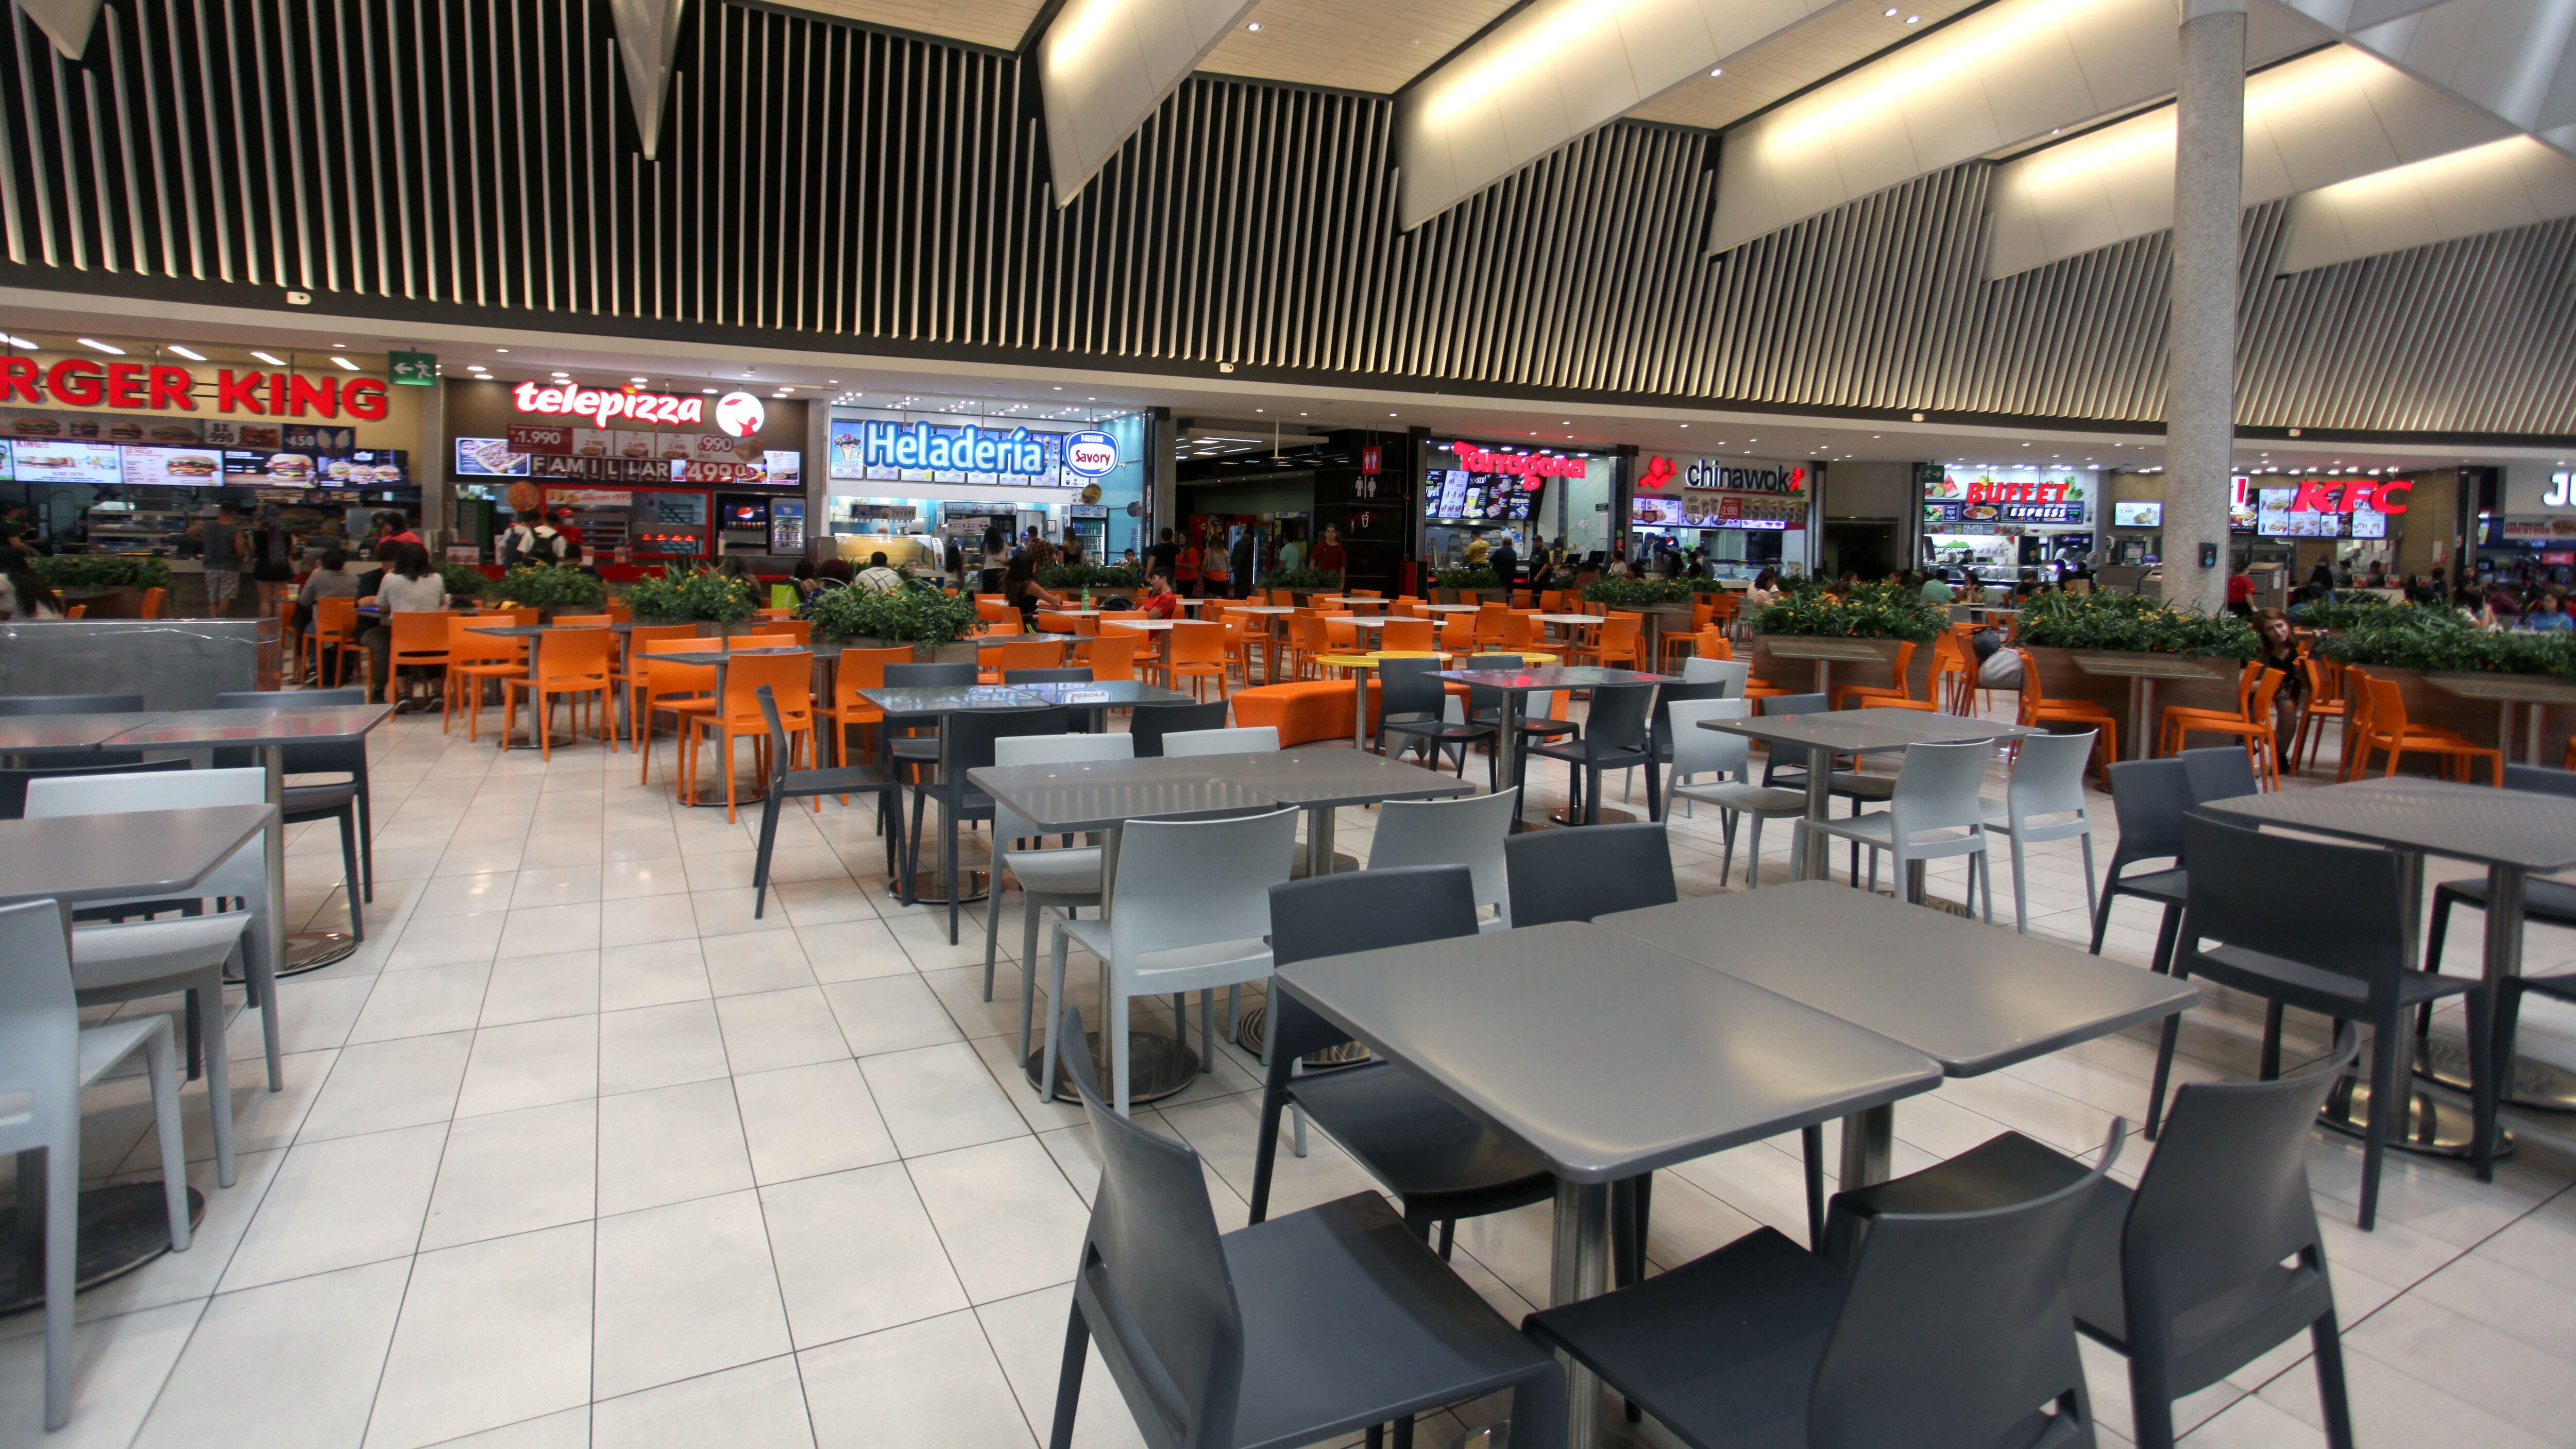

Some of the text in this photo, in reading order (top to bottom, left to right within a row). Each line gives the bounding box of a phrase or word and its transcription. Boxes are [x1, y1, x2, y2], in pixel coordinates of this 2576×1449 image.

[218, 369, 386, 420] KING
[513, 380, 703, 429] telepizza
[514, 431, 561, 444] $1.990
[865, 421, 1043, 474] Heladería
[533, 456, 669, 477] FAMILIAR
[1076, 450, 1110, 466] Savory
[1453, 441, 1586, 490] Tarragona
[1685, 459, 1790, 491] chinawok
[1966, 482, 2069, 504] BUFFET
[2289, 481, 2414, 514] KFC
[2010, 508, 2066, 517] EXPRESS
